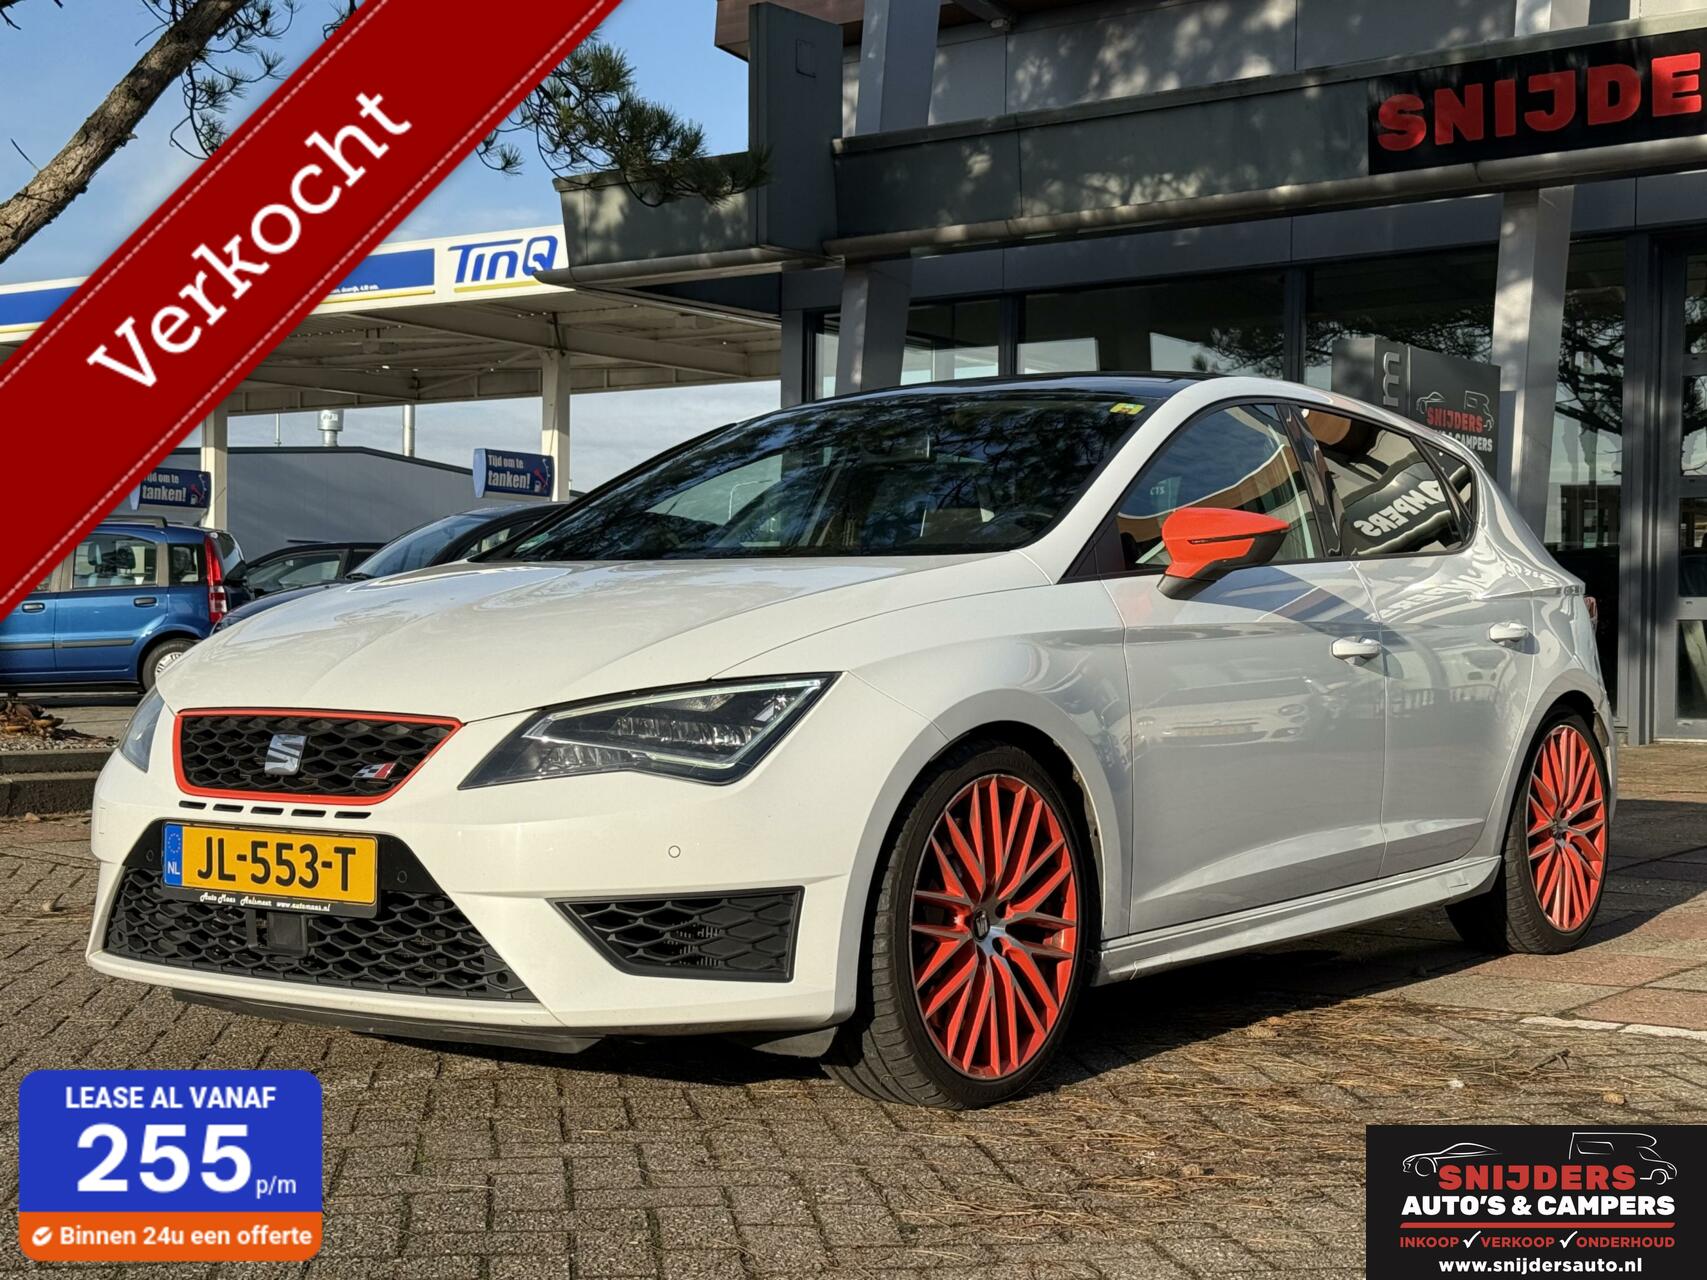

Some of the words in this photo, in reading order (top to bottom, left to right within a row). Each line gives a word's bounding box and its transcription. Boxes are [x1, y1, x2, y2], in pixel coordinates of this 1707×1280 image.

[1378, 52, 1702, 151] SNIJDE
[1427, 406, 1483, 433] SNIJDERS
[488, 455, 502, 467] Tijd
[503, 458, 515, 468] om
[516, 459, 524, 469] te
[158, 474, 170, 482] om
[488, 470, 531, 489] tanken!
[142, 485, 187, 502] tanken!
[167, 860, 181, 876] NL
[197, 836, 356, 892] JL-553-T
